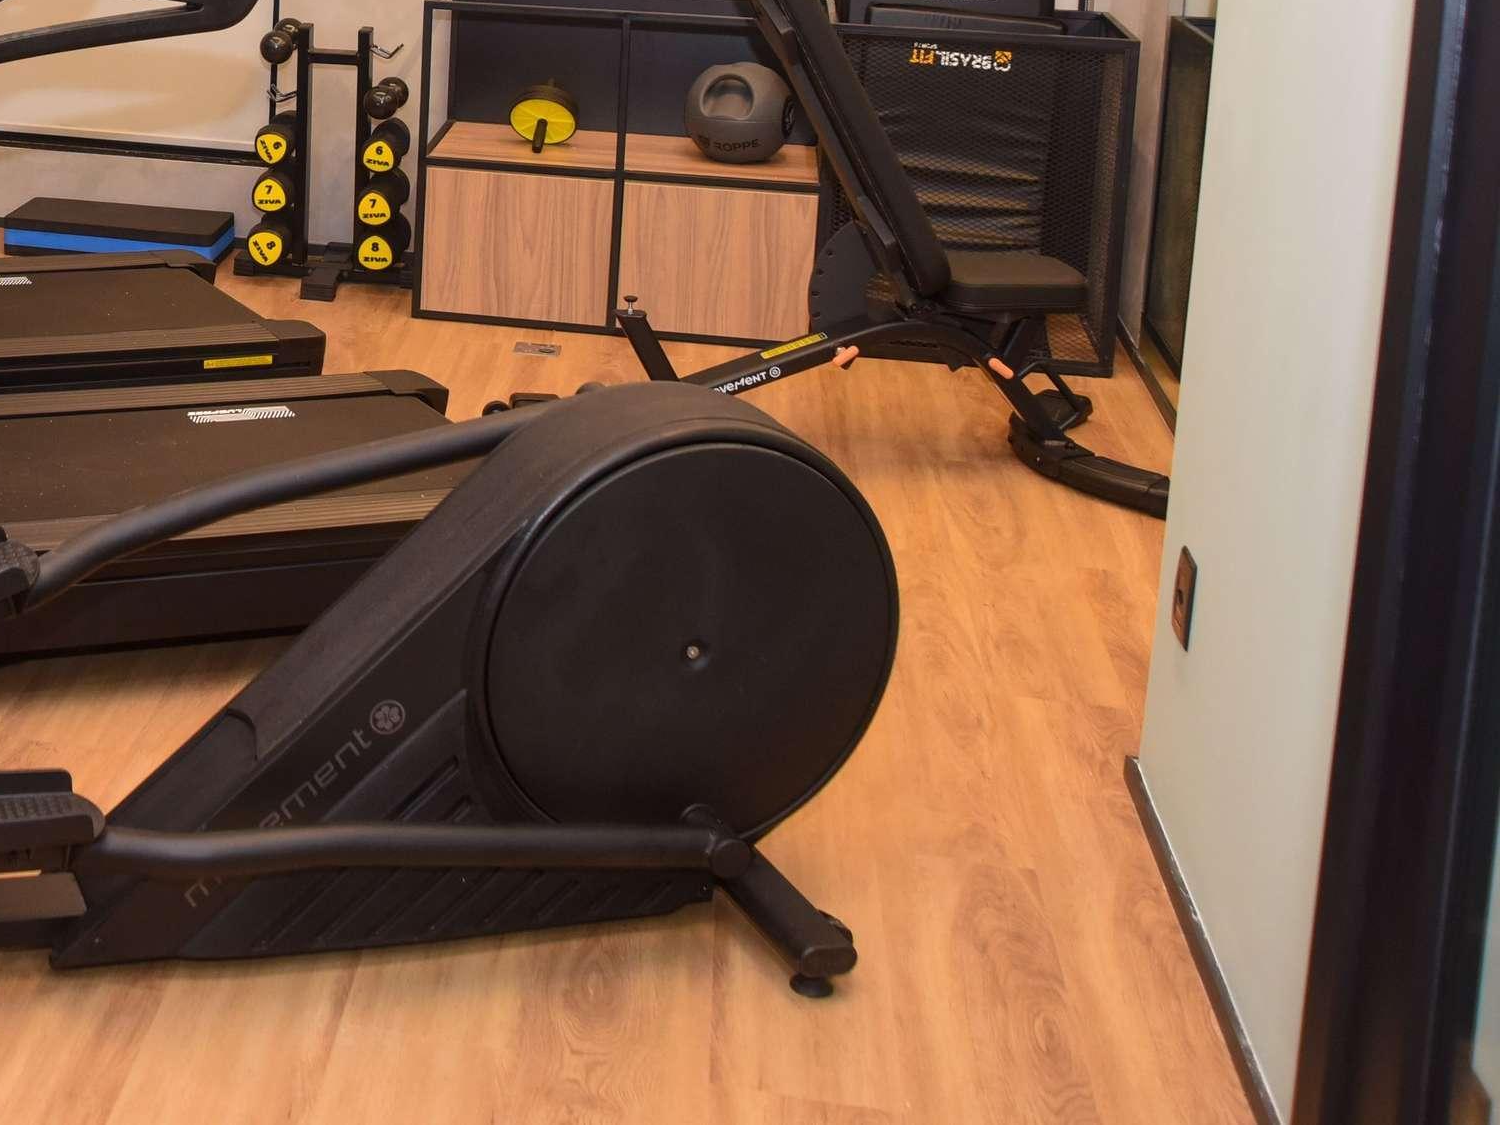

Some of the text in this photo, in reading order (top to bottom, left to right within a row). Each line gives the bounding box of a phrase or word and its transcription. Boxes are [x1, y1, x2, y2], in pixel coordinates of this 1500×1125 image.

[273, 141, 283, 150] 6
[375, 146, 383, 155] 6
[366, 158, 390, 167] ZIVA
[264, 185, 273, 195] 7
[368, 199, 377, 208] 7
[266, 240, 276, 251] 8
[371, 242, 380, 252] 8
[252, 240, 269, 263] ZIVA
[183, 727, 373, 909] mement
